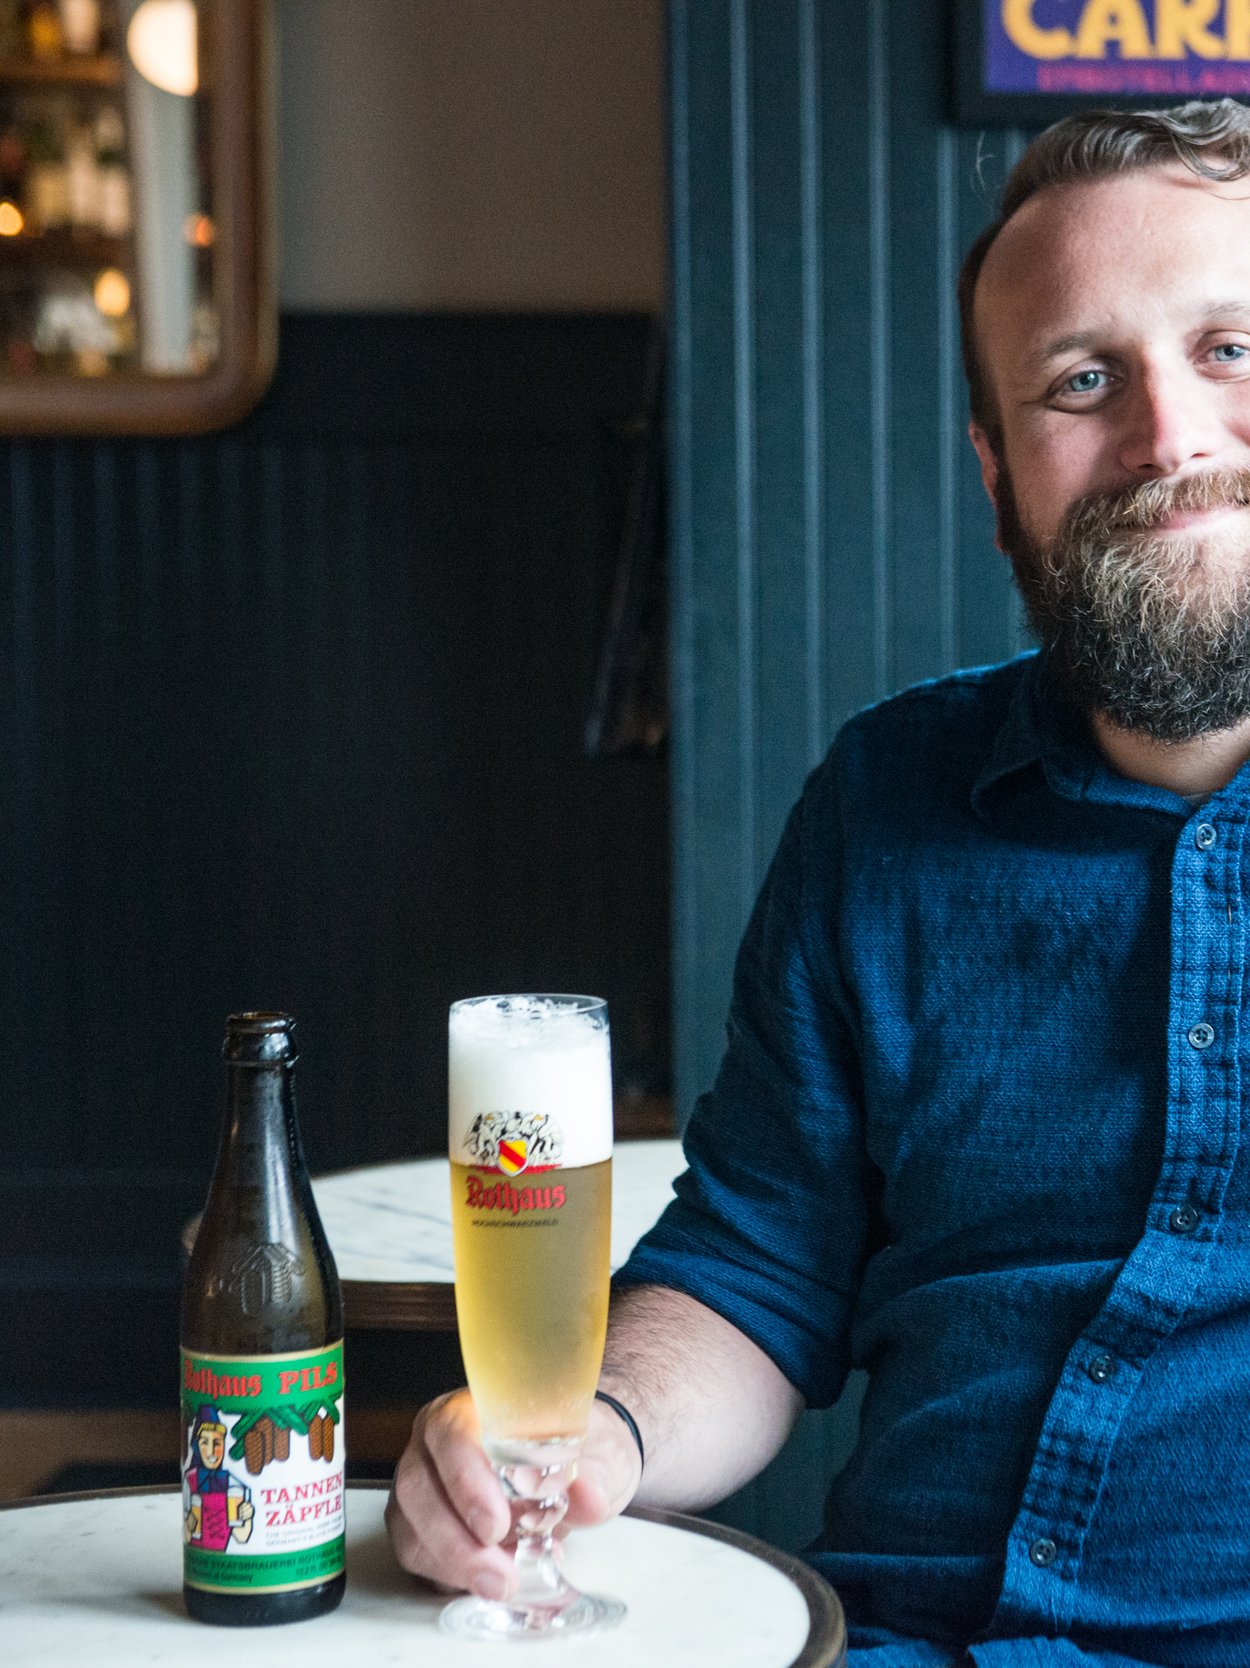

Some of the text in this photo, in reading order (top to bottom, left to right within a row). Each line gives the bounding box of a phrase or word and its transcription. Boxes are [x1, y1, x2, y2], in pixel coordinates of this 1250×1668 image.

[466, 1175, 567, 1216] Rothaus
[184, 1359, 337, 1400] Rothaus PILS
[261, 1470, 343, 1506] TANNEN
[265, 1494, 343, 1527] ZÄPFLE
